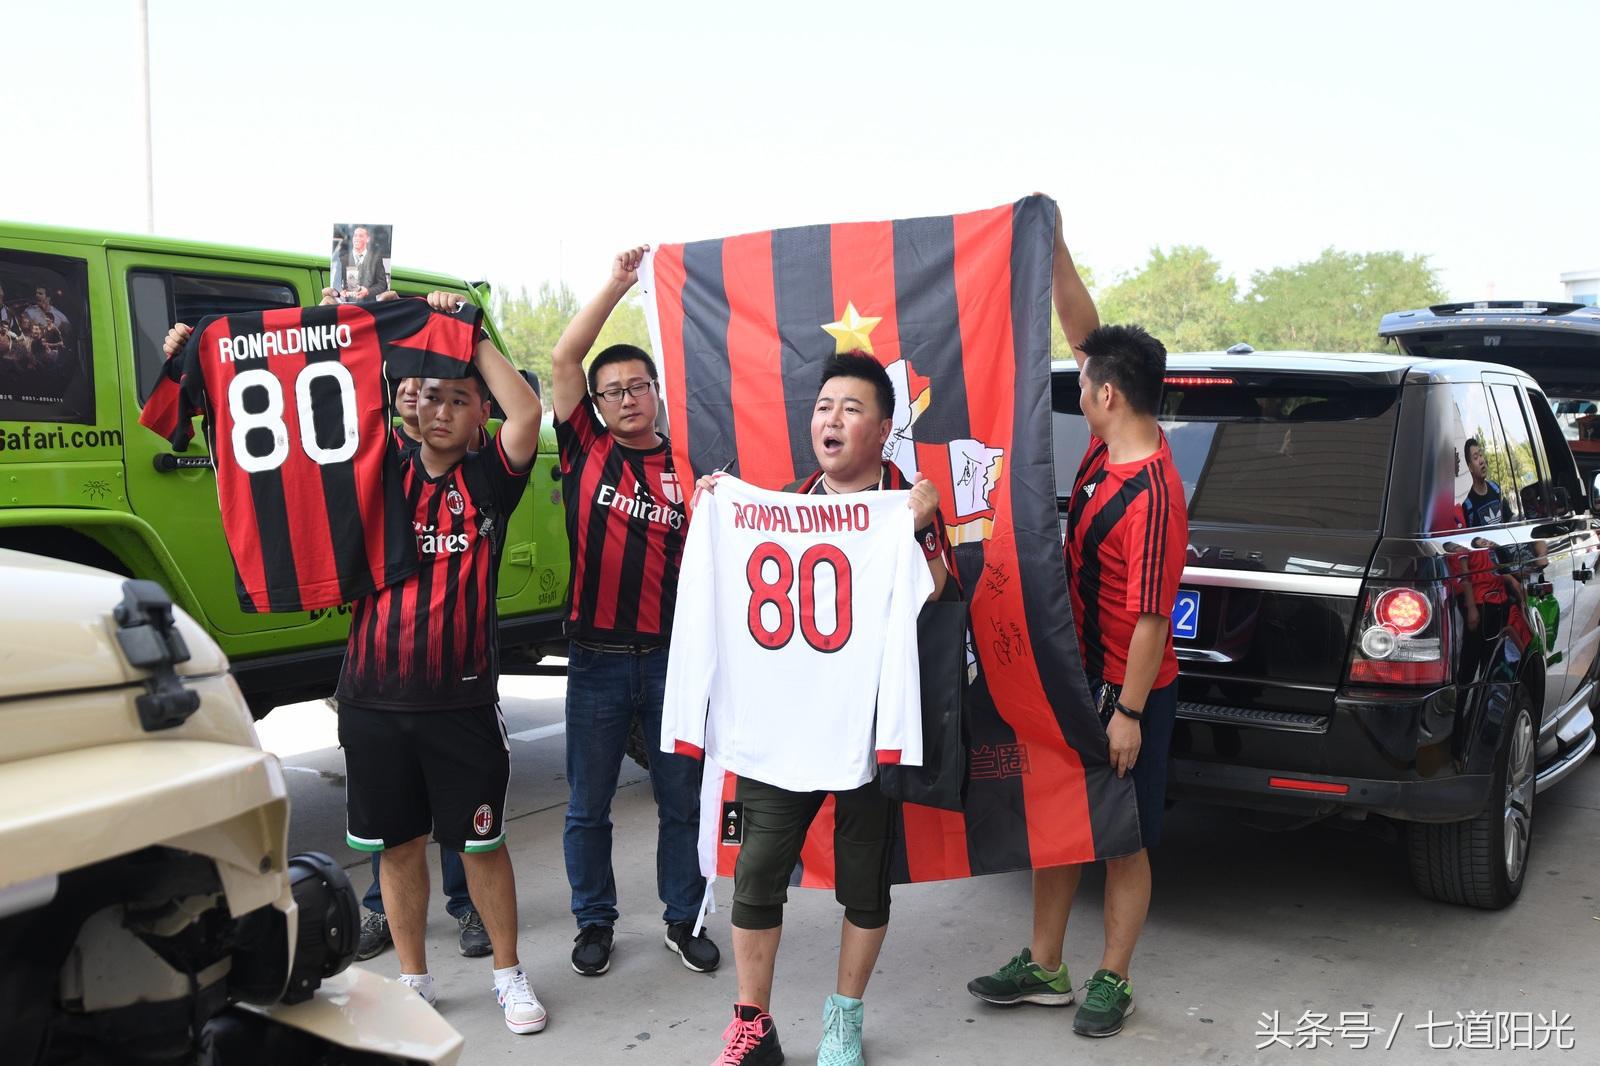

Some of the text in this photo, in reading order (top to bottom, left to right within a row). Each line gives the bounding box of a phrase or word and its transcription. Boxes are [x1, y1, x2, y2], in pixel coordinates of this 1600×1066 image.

[218, 324, 352, 363] RONALDINHO
[228, 360, 360, 473] 80
[597, 484, 684, 530] Emirates
[732, 502, 869, 533] RONALDINHO
[415, 532, 469, 554] rates
[1186, 543, 1264, 562] VER
[746, 541, 853, 654] 80
